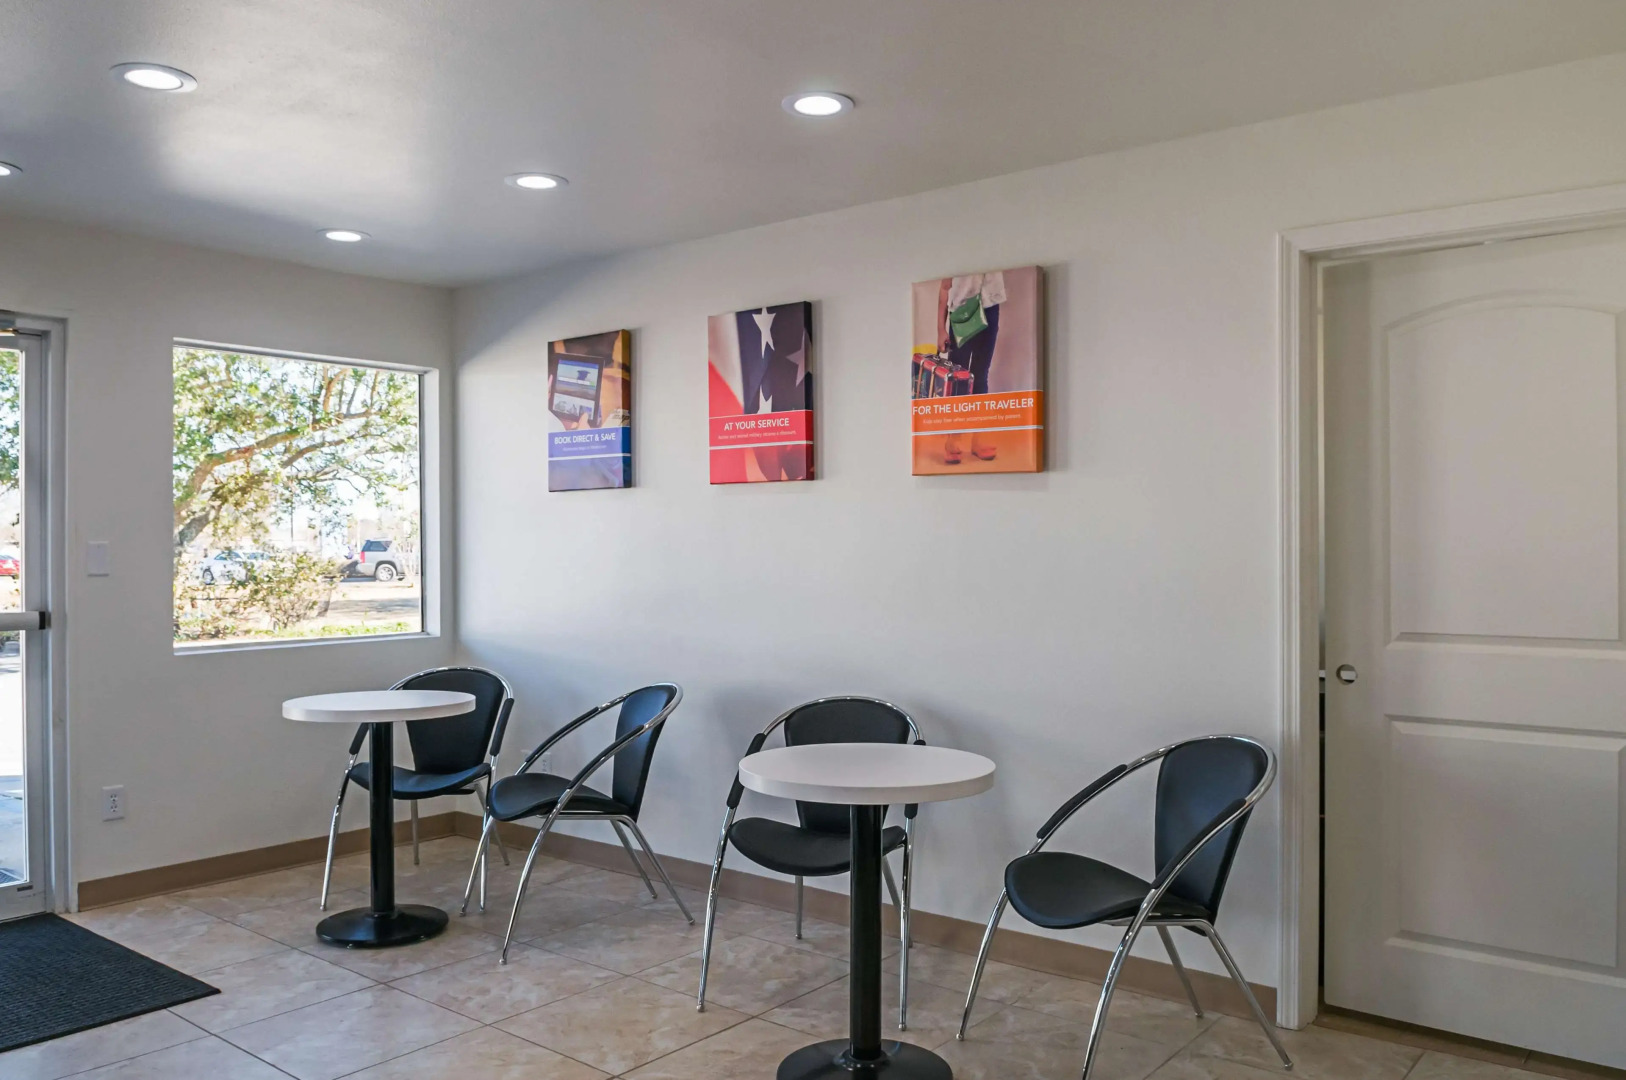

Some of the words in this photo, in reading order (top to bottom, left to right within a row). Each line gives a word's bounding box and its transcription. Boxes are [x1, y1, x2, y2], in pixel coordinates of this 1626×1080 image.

[912, 405, 931, 415] FOR
[933, 404, 951, 414] THE
[953, 401, 981, 412] LIGHT
[984, 398, 1034, 410] TRAVELER
[724, 422, 733, 431] AT
[735, 420, 755, 430] YOUR
[758, 418, 789, 428] SERVICE
[554, 436, 571, 444] BOOK
[573, 434, 593, 443] DIRECT
[595, 433, 599, 441] &
[601, 432, 616, 440] SAVE
